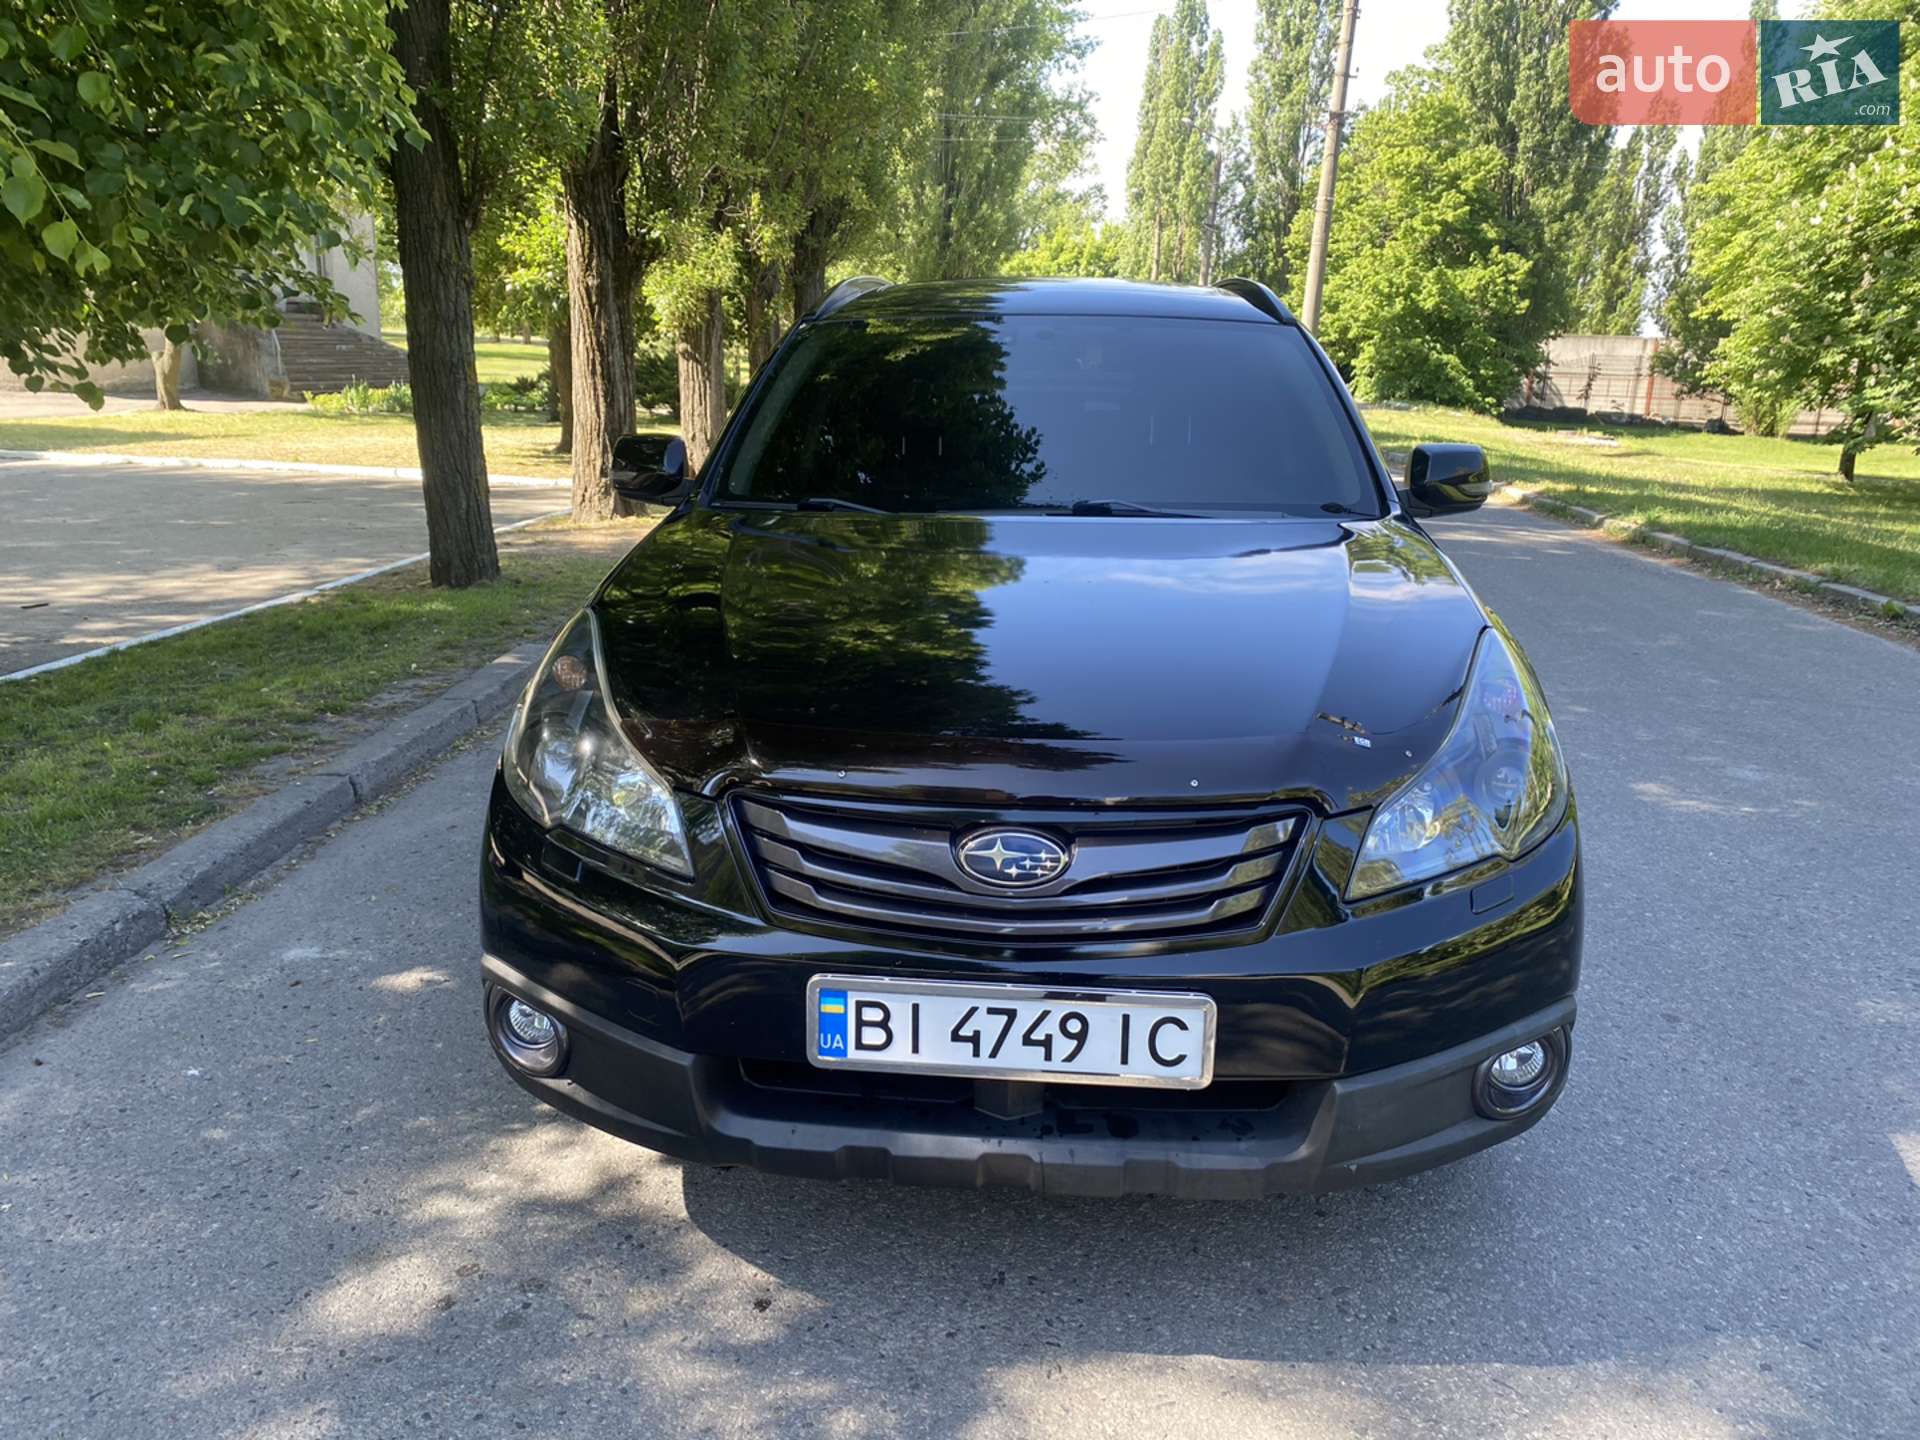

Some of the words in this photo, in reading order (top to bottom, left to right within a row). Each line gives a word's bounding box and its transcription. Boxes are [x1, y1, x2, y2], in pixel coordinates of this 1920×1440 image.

[819, 1032, 845, 1050] UA
[854, 999, 920, 1055] BI
[949, 1005, 1090, 1063] 4749
[1120, 1013, 1190, 1068] IC
